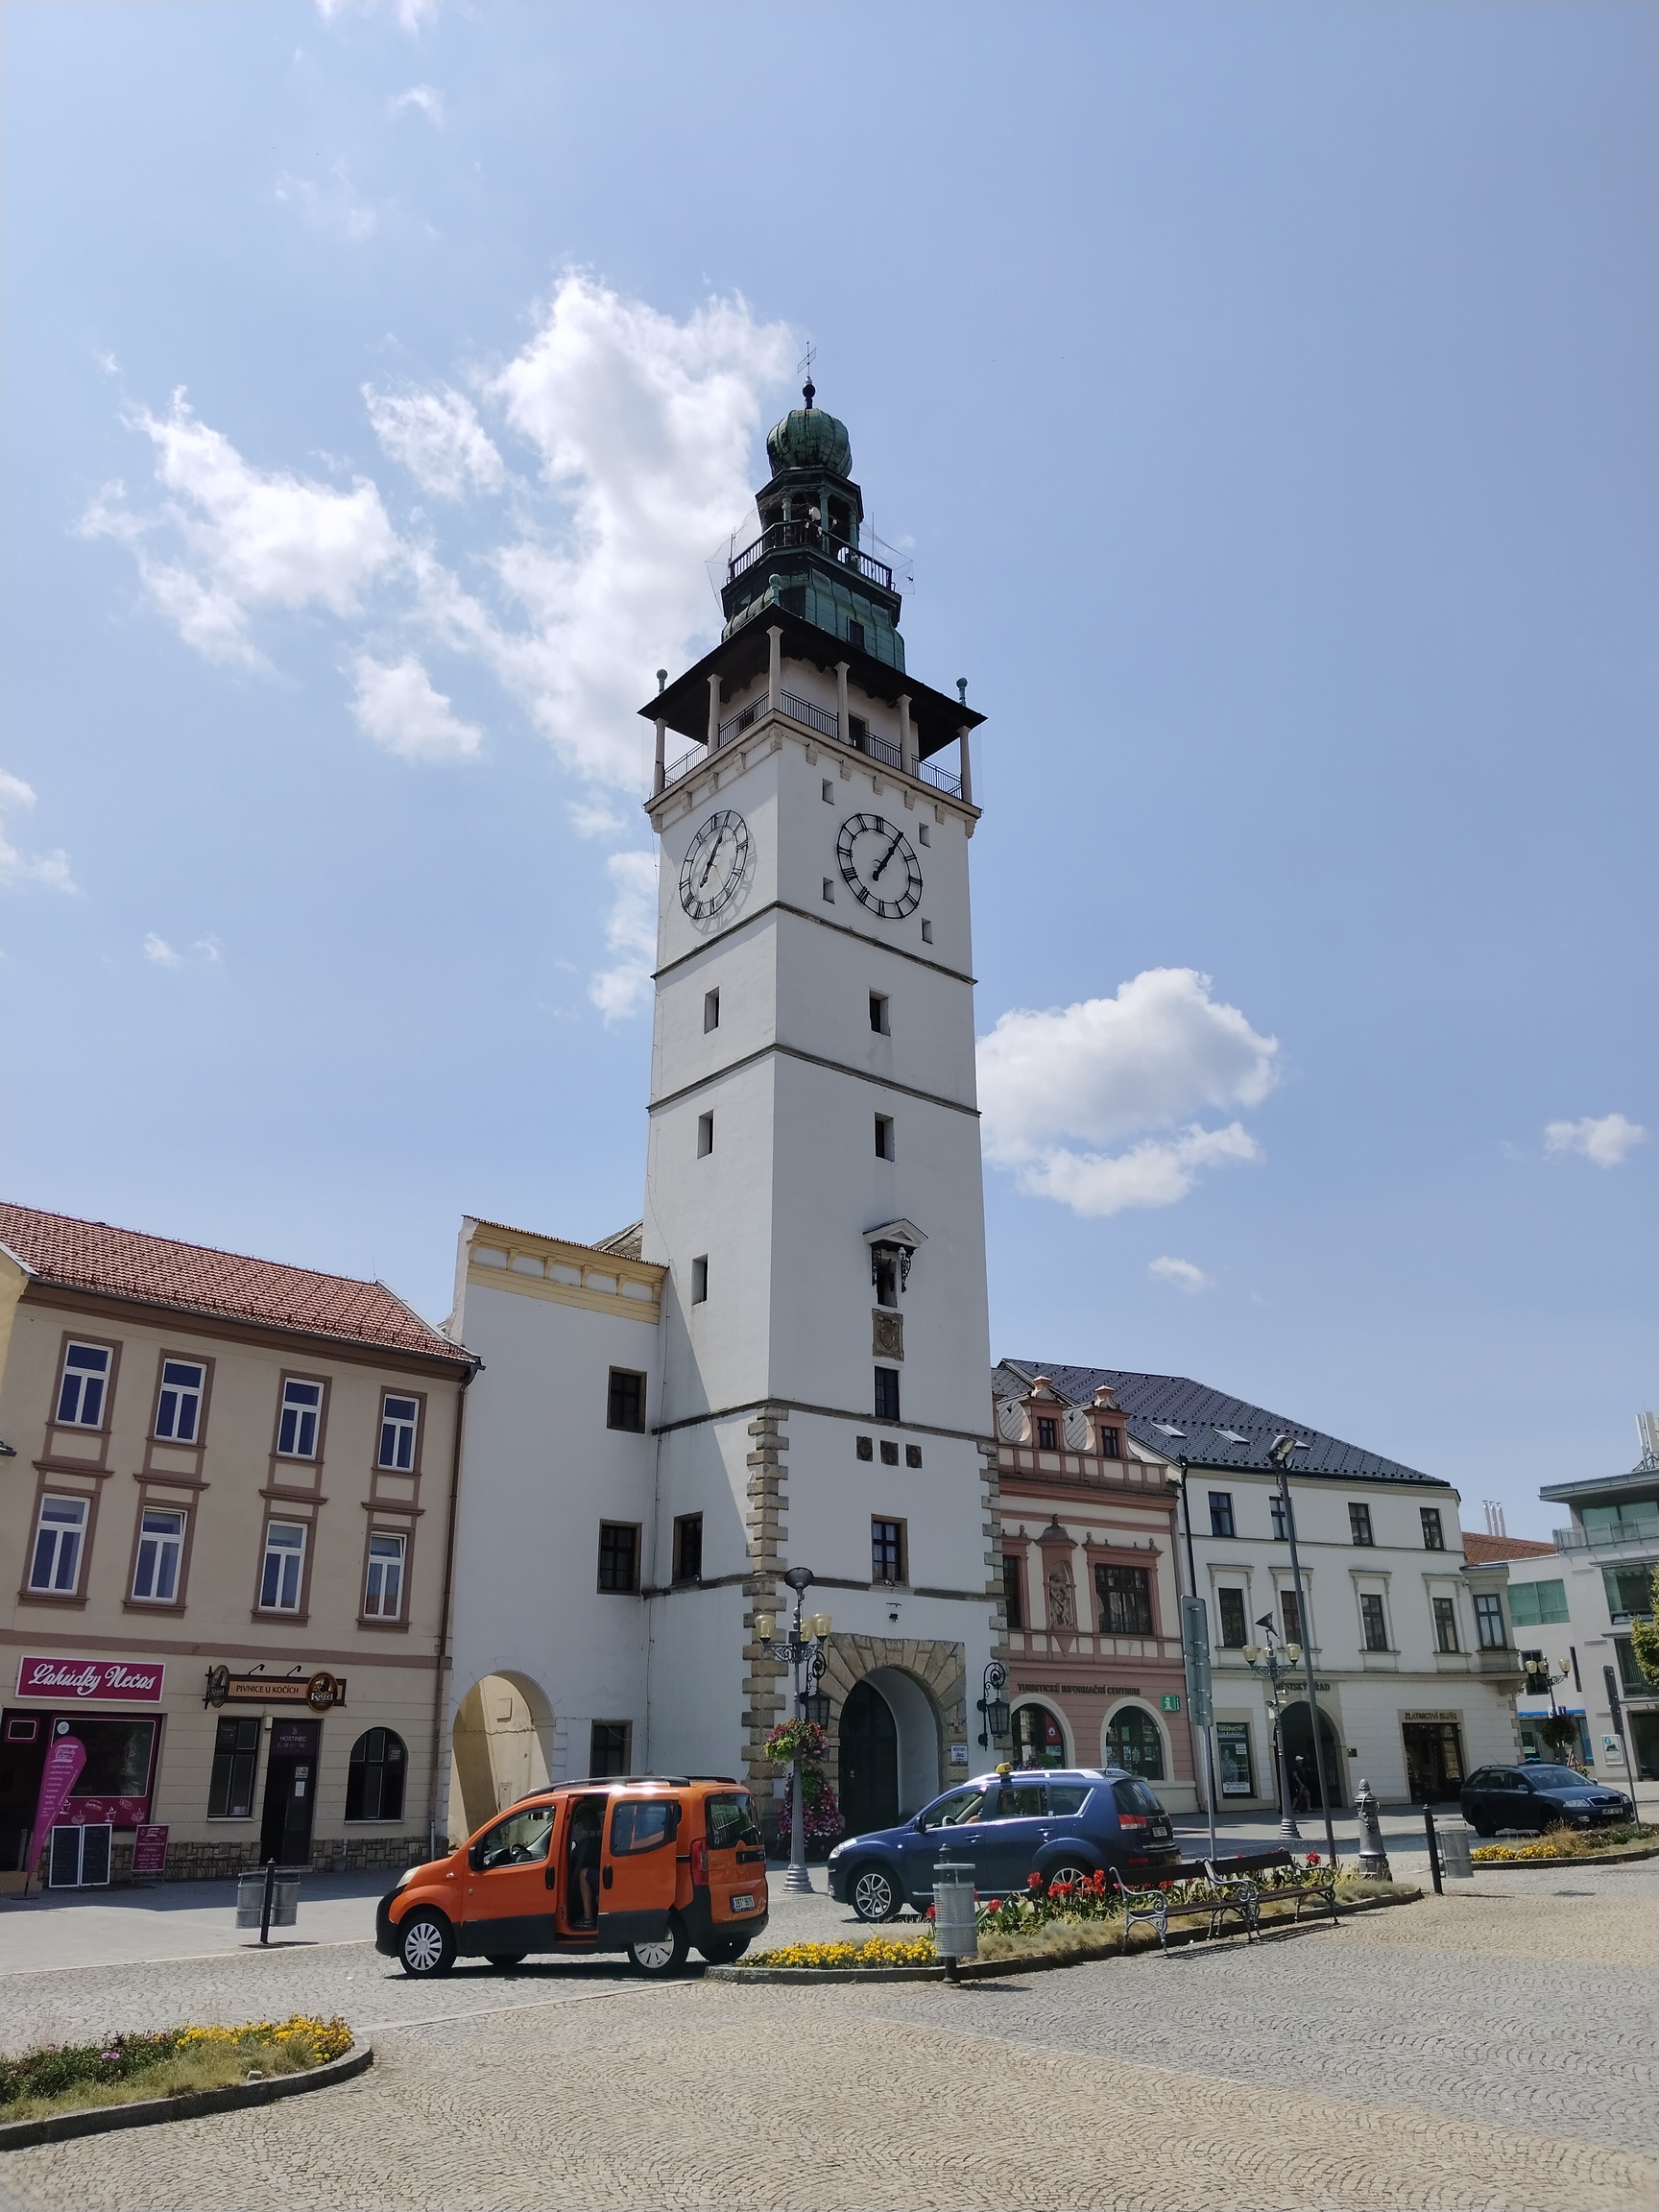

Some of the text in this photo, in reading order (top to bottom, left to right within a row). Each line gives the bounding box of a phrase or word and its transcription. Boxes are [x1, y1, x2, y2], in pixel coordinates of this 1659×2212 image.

[105, 1666, 157, 1690] Nečas
[272, 1686, 300, 1695] KOČÍCH
[1018, 1683, 1141, 1695] TURISTICKÉ INFORMAČNÍ CENTRUM
[310, 1692, 334, 1701] Kozel
